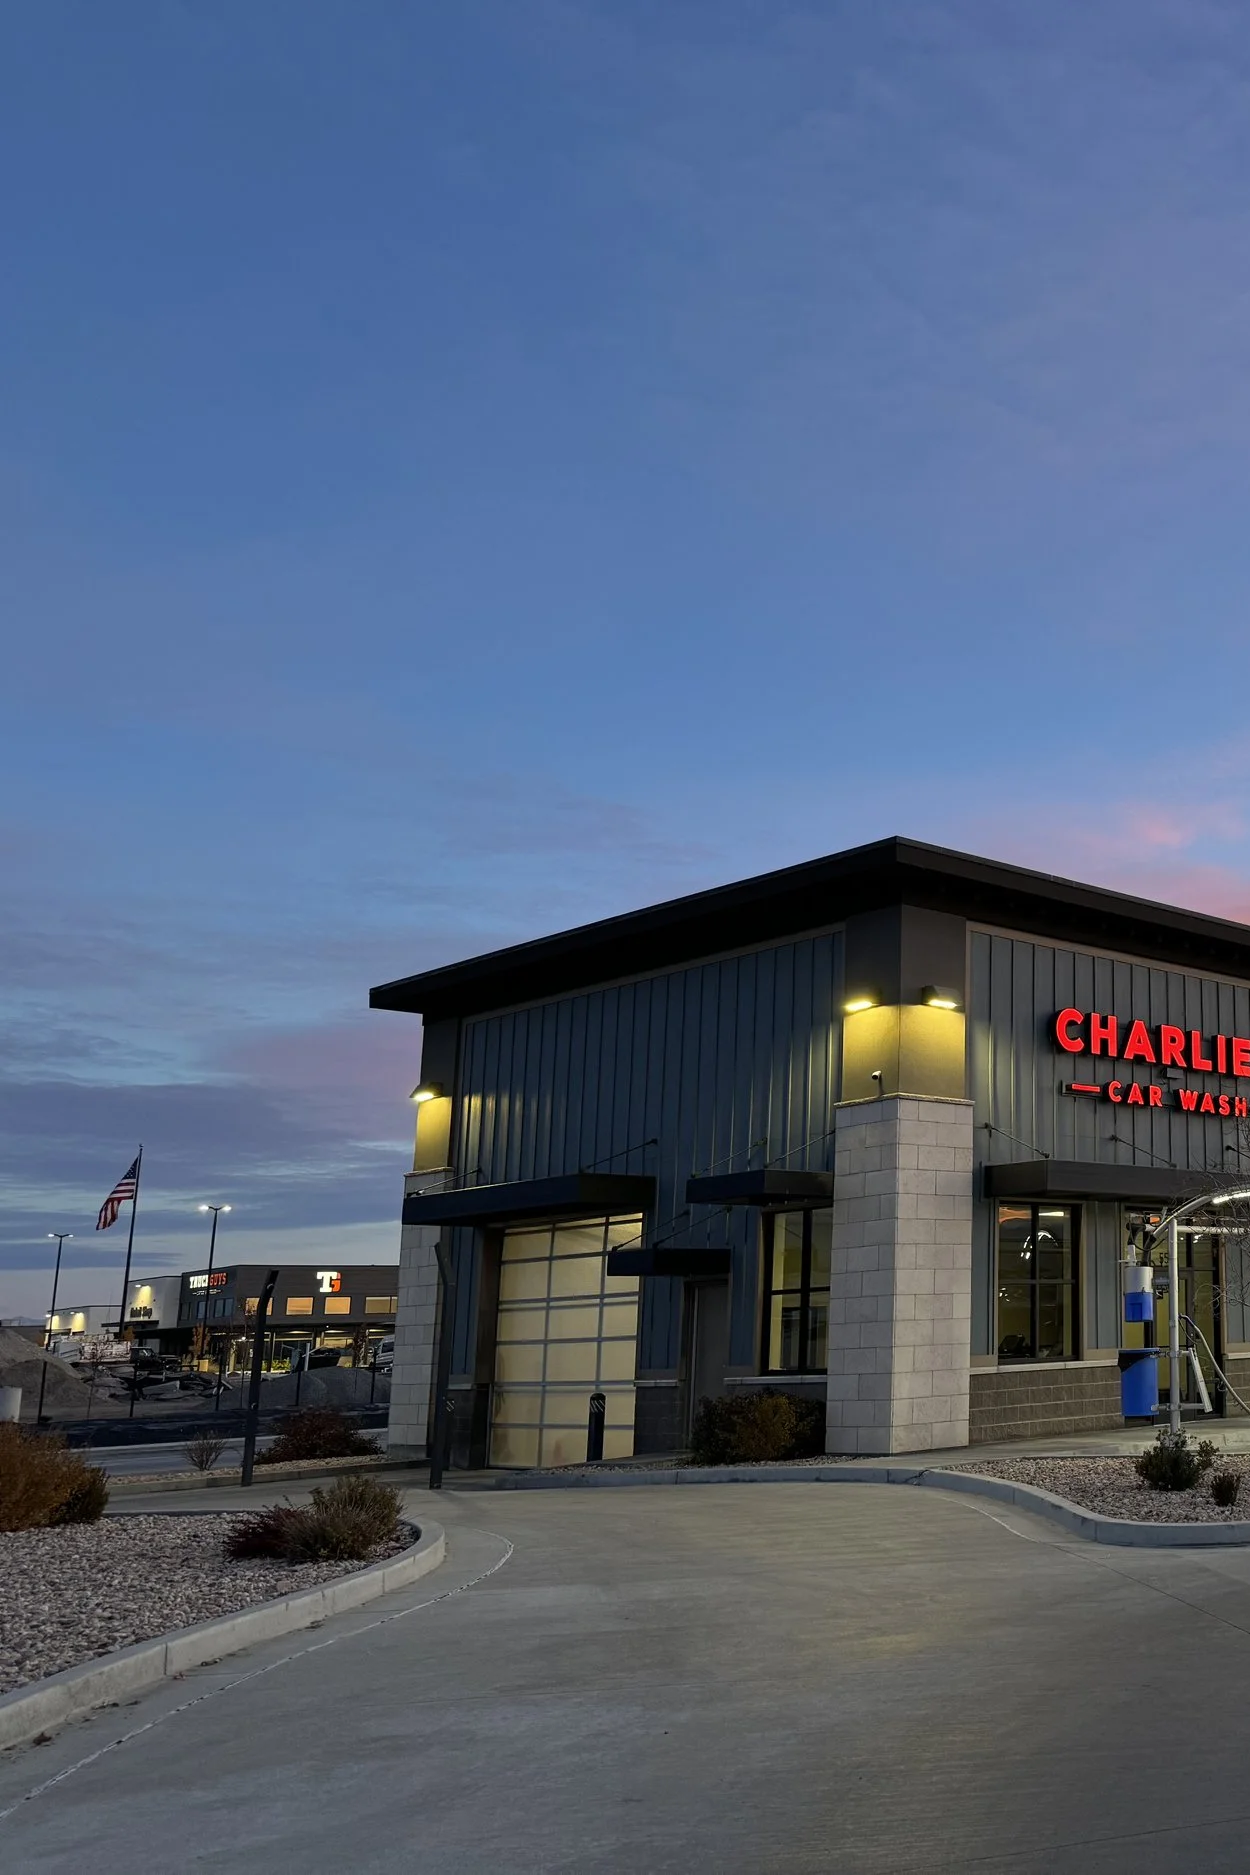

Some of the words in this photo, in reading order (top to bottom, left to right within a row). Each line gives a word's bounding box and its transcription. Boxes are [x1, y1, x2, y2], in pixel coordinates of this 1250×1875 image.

[1107, 1080, 1163, 1107] CAR
[1178, 1089, 1248, 1118] WASH
[209, 1273, 227, 1286] GUYS
